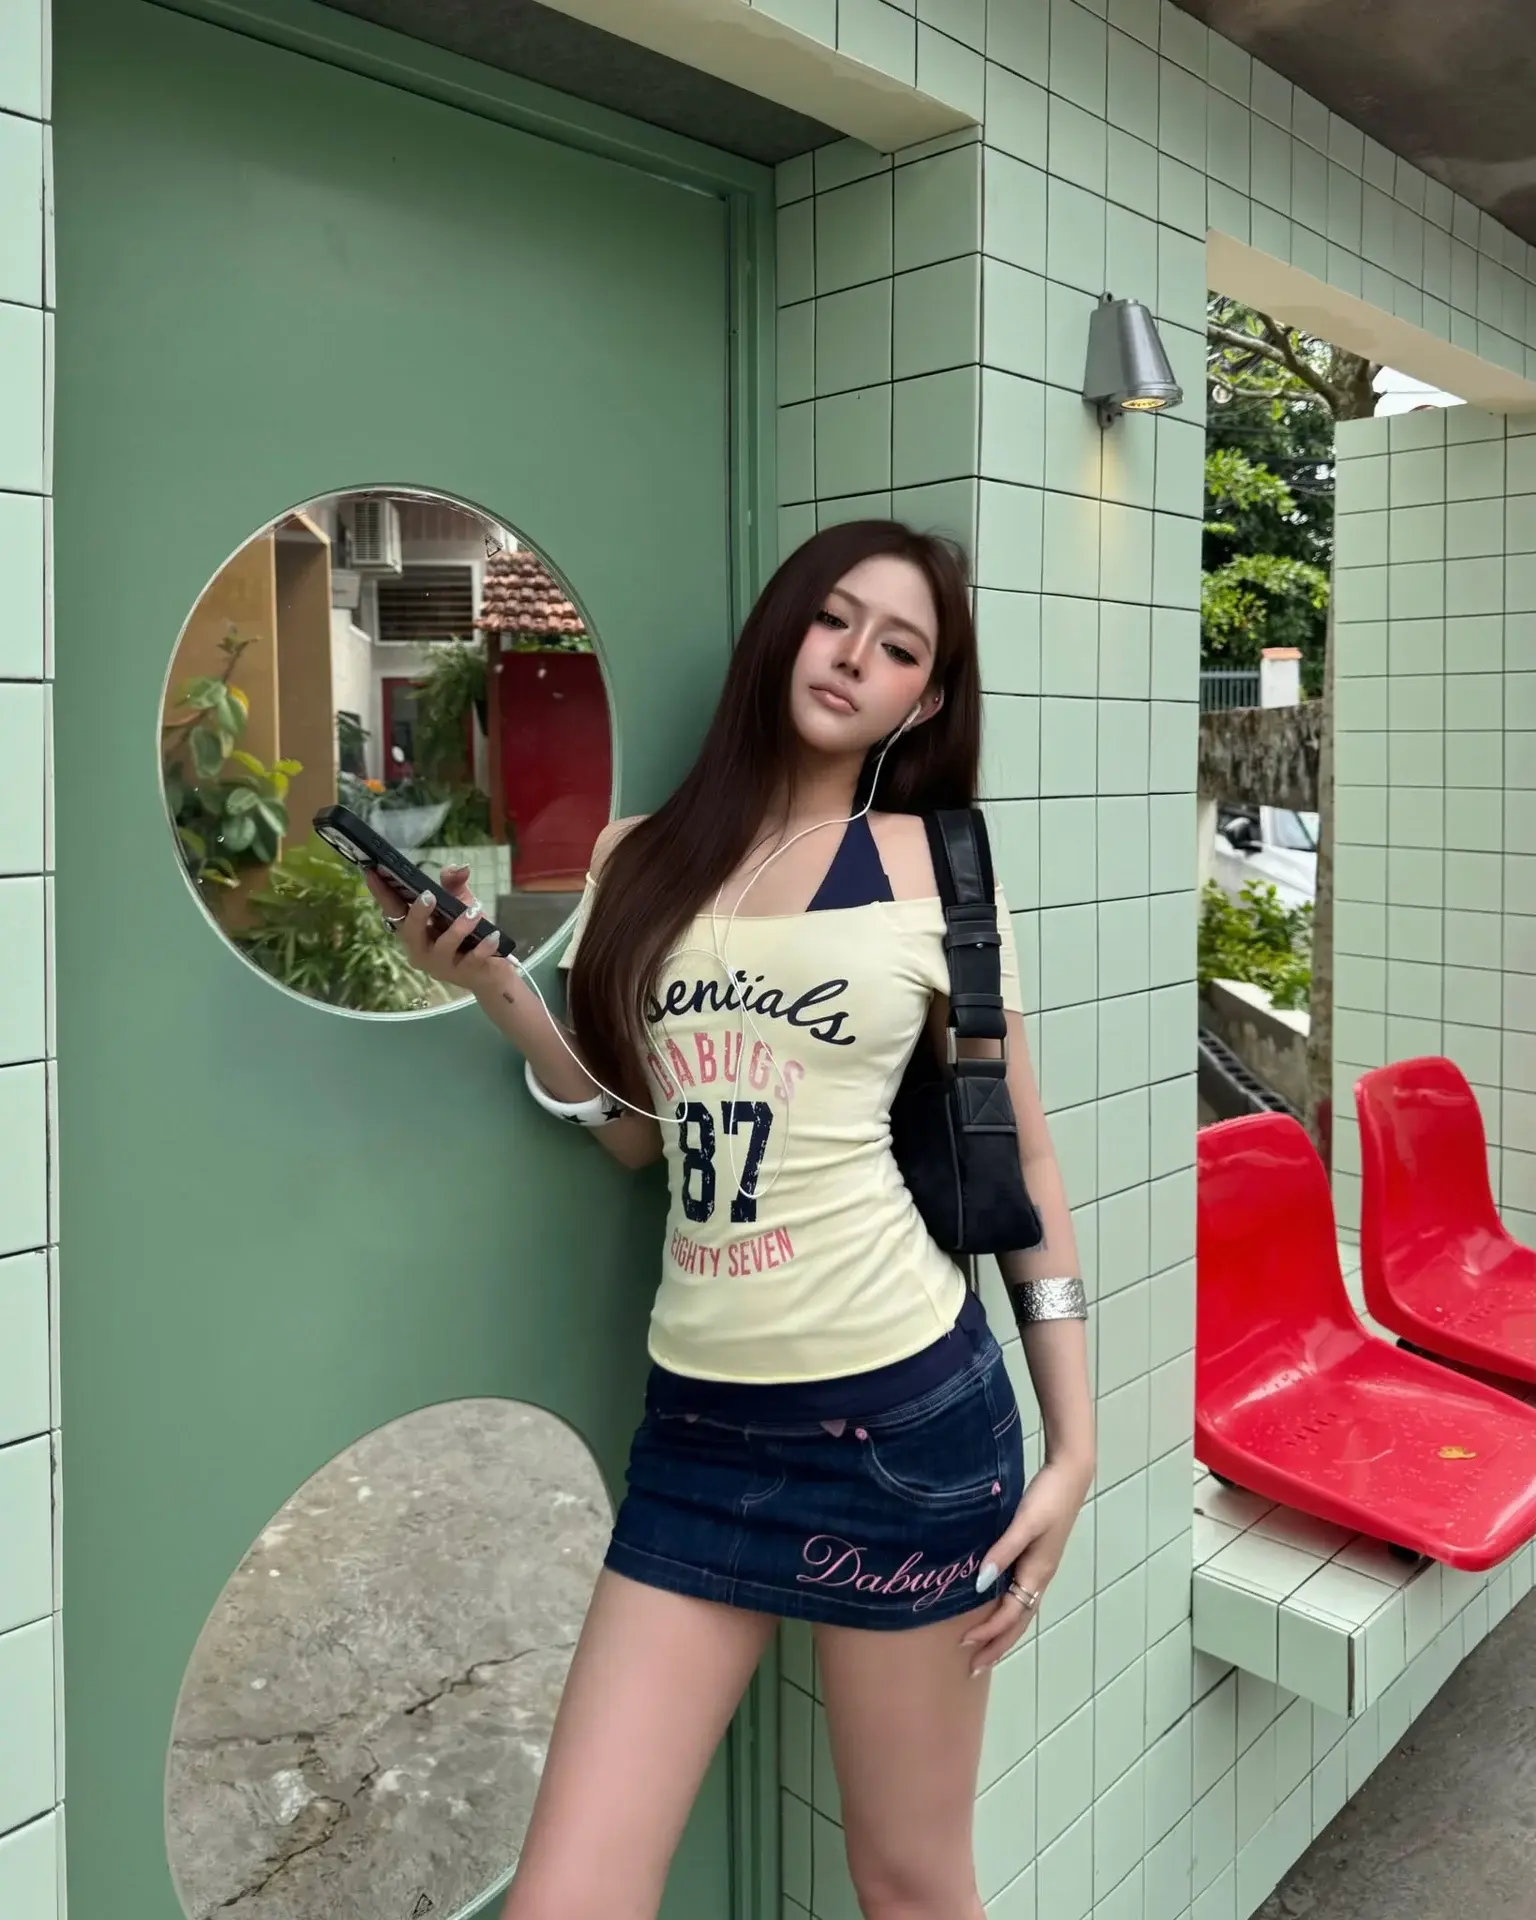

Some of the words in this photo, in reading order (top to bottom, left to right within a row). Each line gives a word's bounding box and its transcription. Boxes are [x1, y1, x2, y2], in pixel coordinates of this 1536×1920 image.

[647, 1030, 805, 1102] DABUGS
[675, 1100, 774, 1224] 87
[671, 1226, 721, 1278] EIGHTY
[728, 1225, 795, 1278] SEVEN
[796, 1534, 981, 1613] Dabugs
